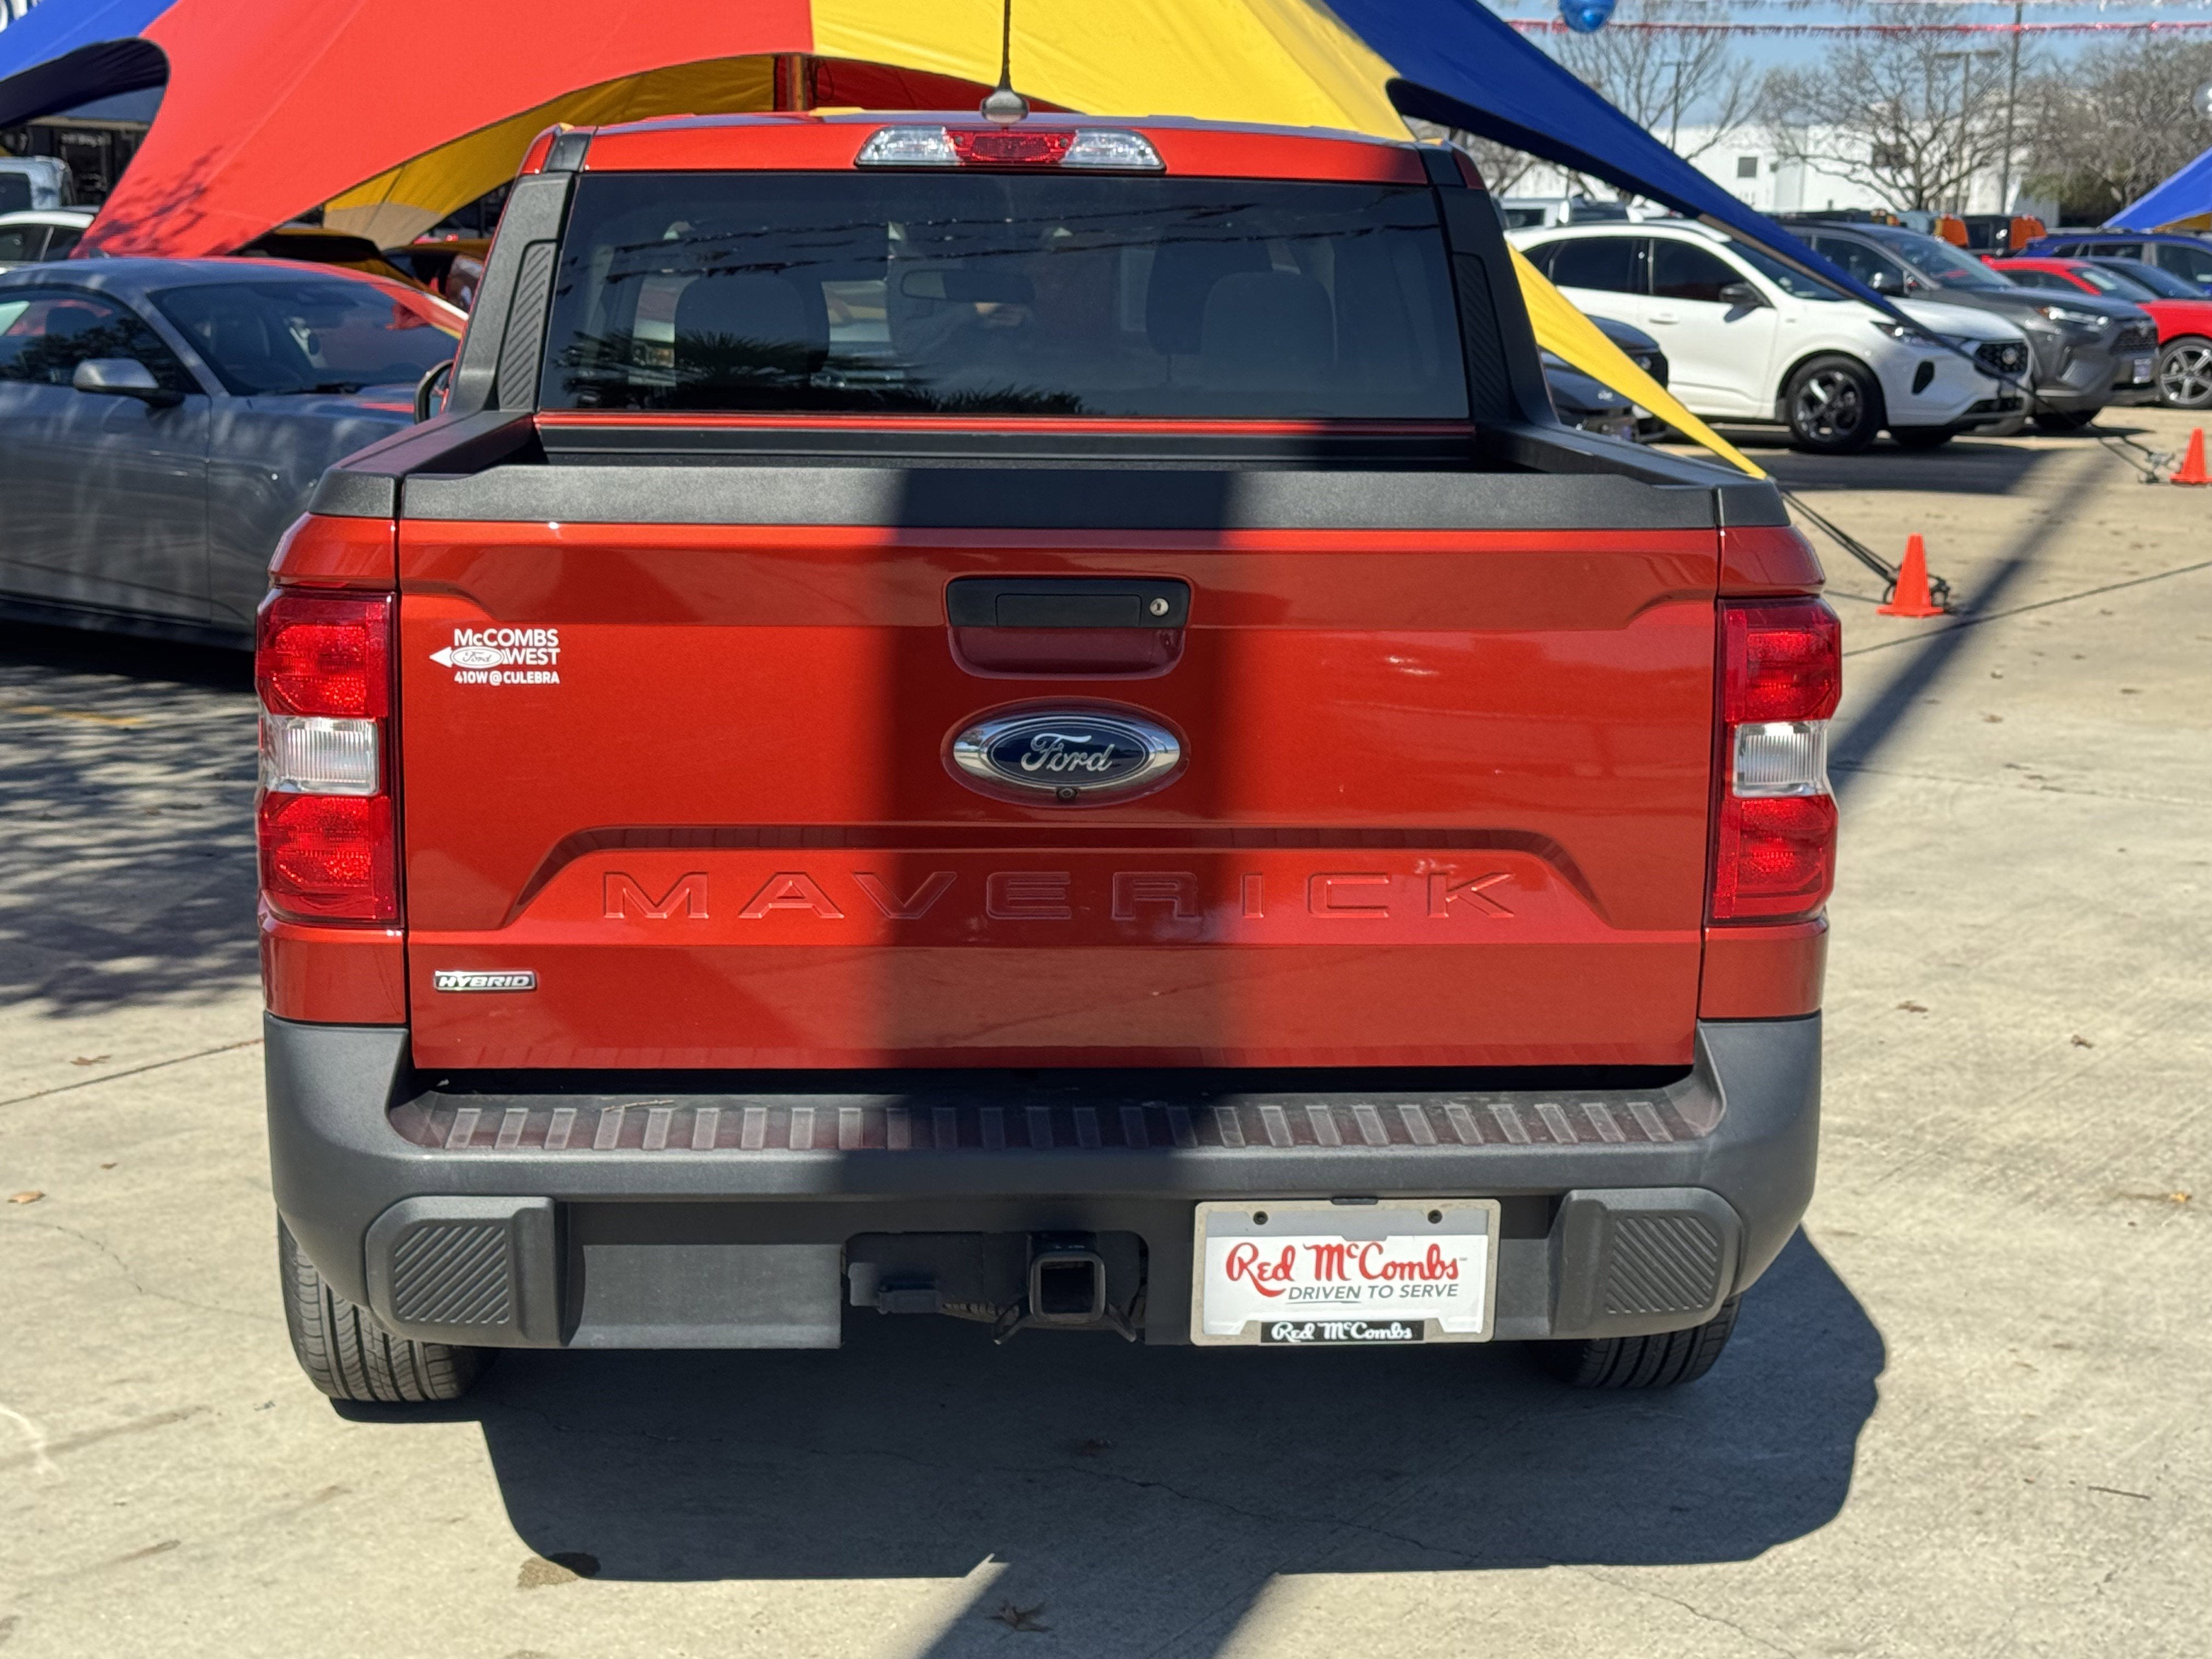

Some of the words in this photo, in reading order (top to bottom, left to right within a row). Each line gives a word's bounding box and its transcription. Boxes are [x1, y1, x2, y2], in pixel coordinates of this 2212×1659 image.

[454, 628, 559, 647] McCOMBS
[462, 651, 492, 662] Ford
[505, 648, 561, 665] WEST
[1021, 732, 1115, 772] Ford
[603, 871, 1515, 919] MAVERICK
[439, 976, 529, 987] HYBRID
[1226, 1242, 1296, 1297] Red
[1303, 1241, 1459, 1282] McCombs
[1288, 1286, 1362, 1300] DRIVEN
[1368, 1285, 1394, 1299] TO
[1399, 1283, 1459, 1298] SERVE
[1271, 1321, 1316, 1343] Red
[1317, 1321, 1413, 1340] McCombs
